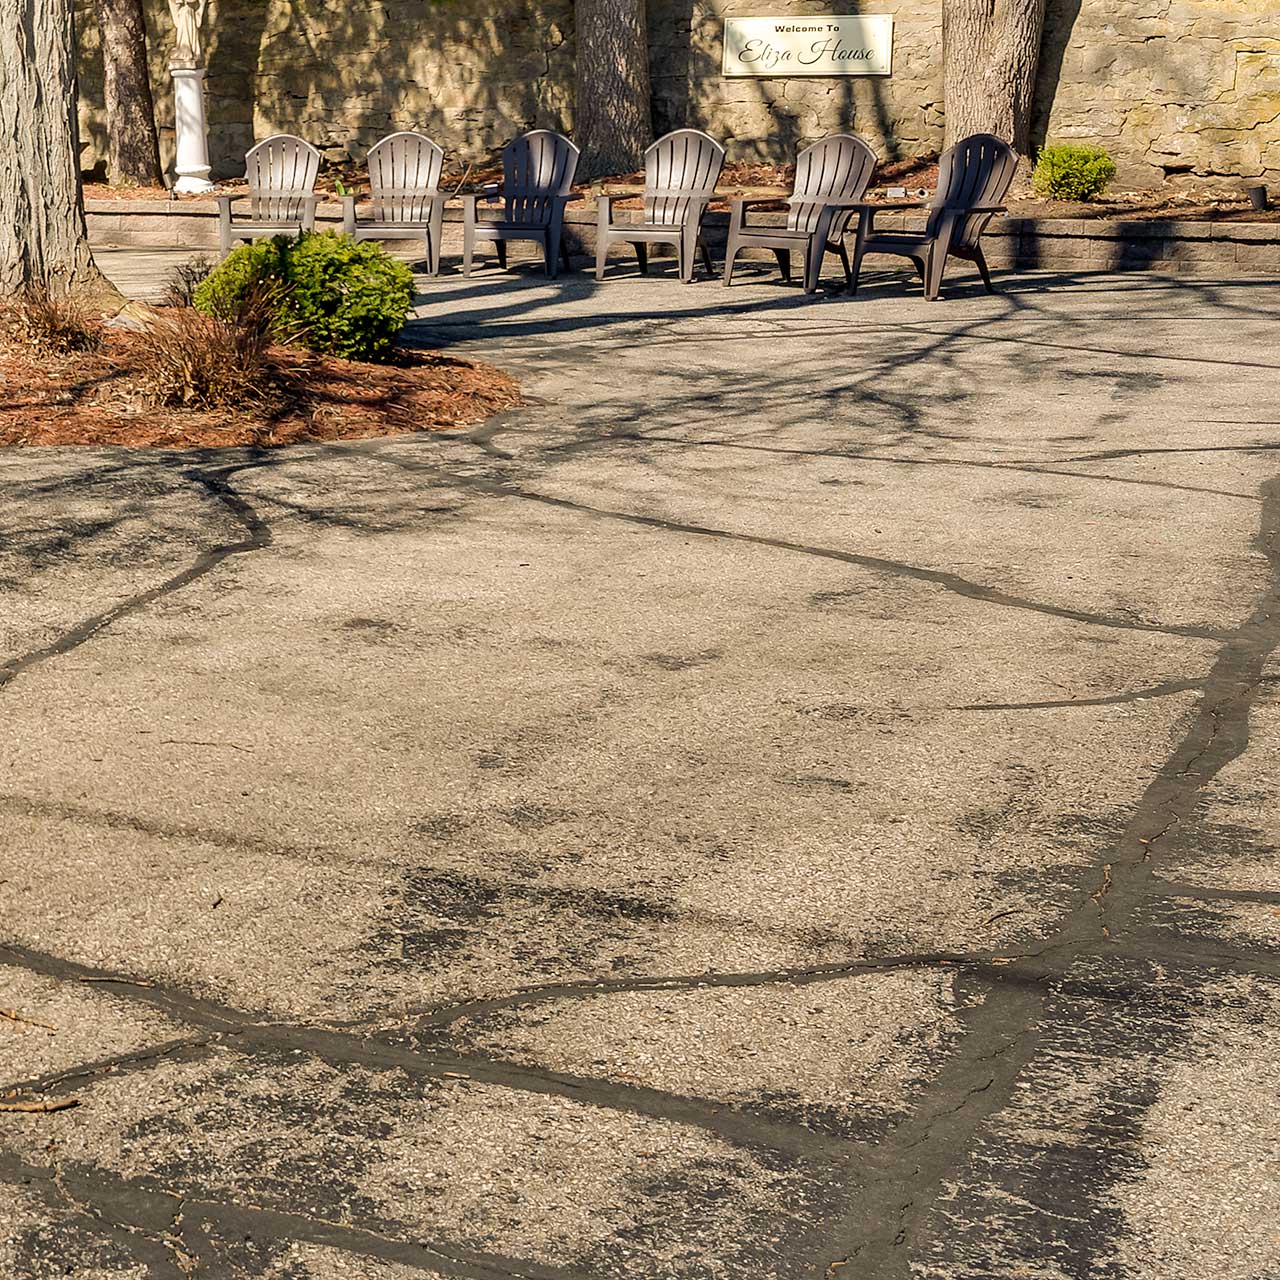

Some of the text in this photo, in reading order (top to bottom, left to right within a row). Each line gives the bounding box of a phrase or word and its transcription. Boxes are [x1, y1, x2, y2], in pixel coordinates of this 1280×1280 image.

[775, 24, 840, 33] Welcome To
[738, 38, 874, 68] Eliza House
